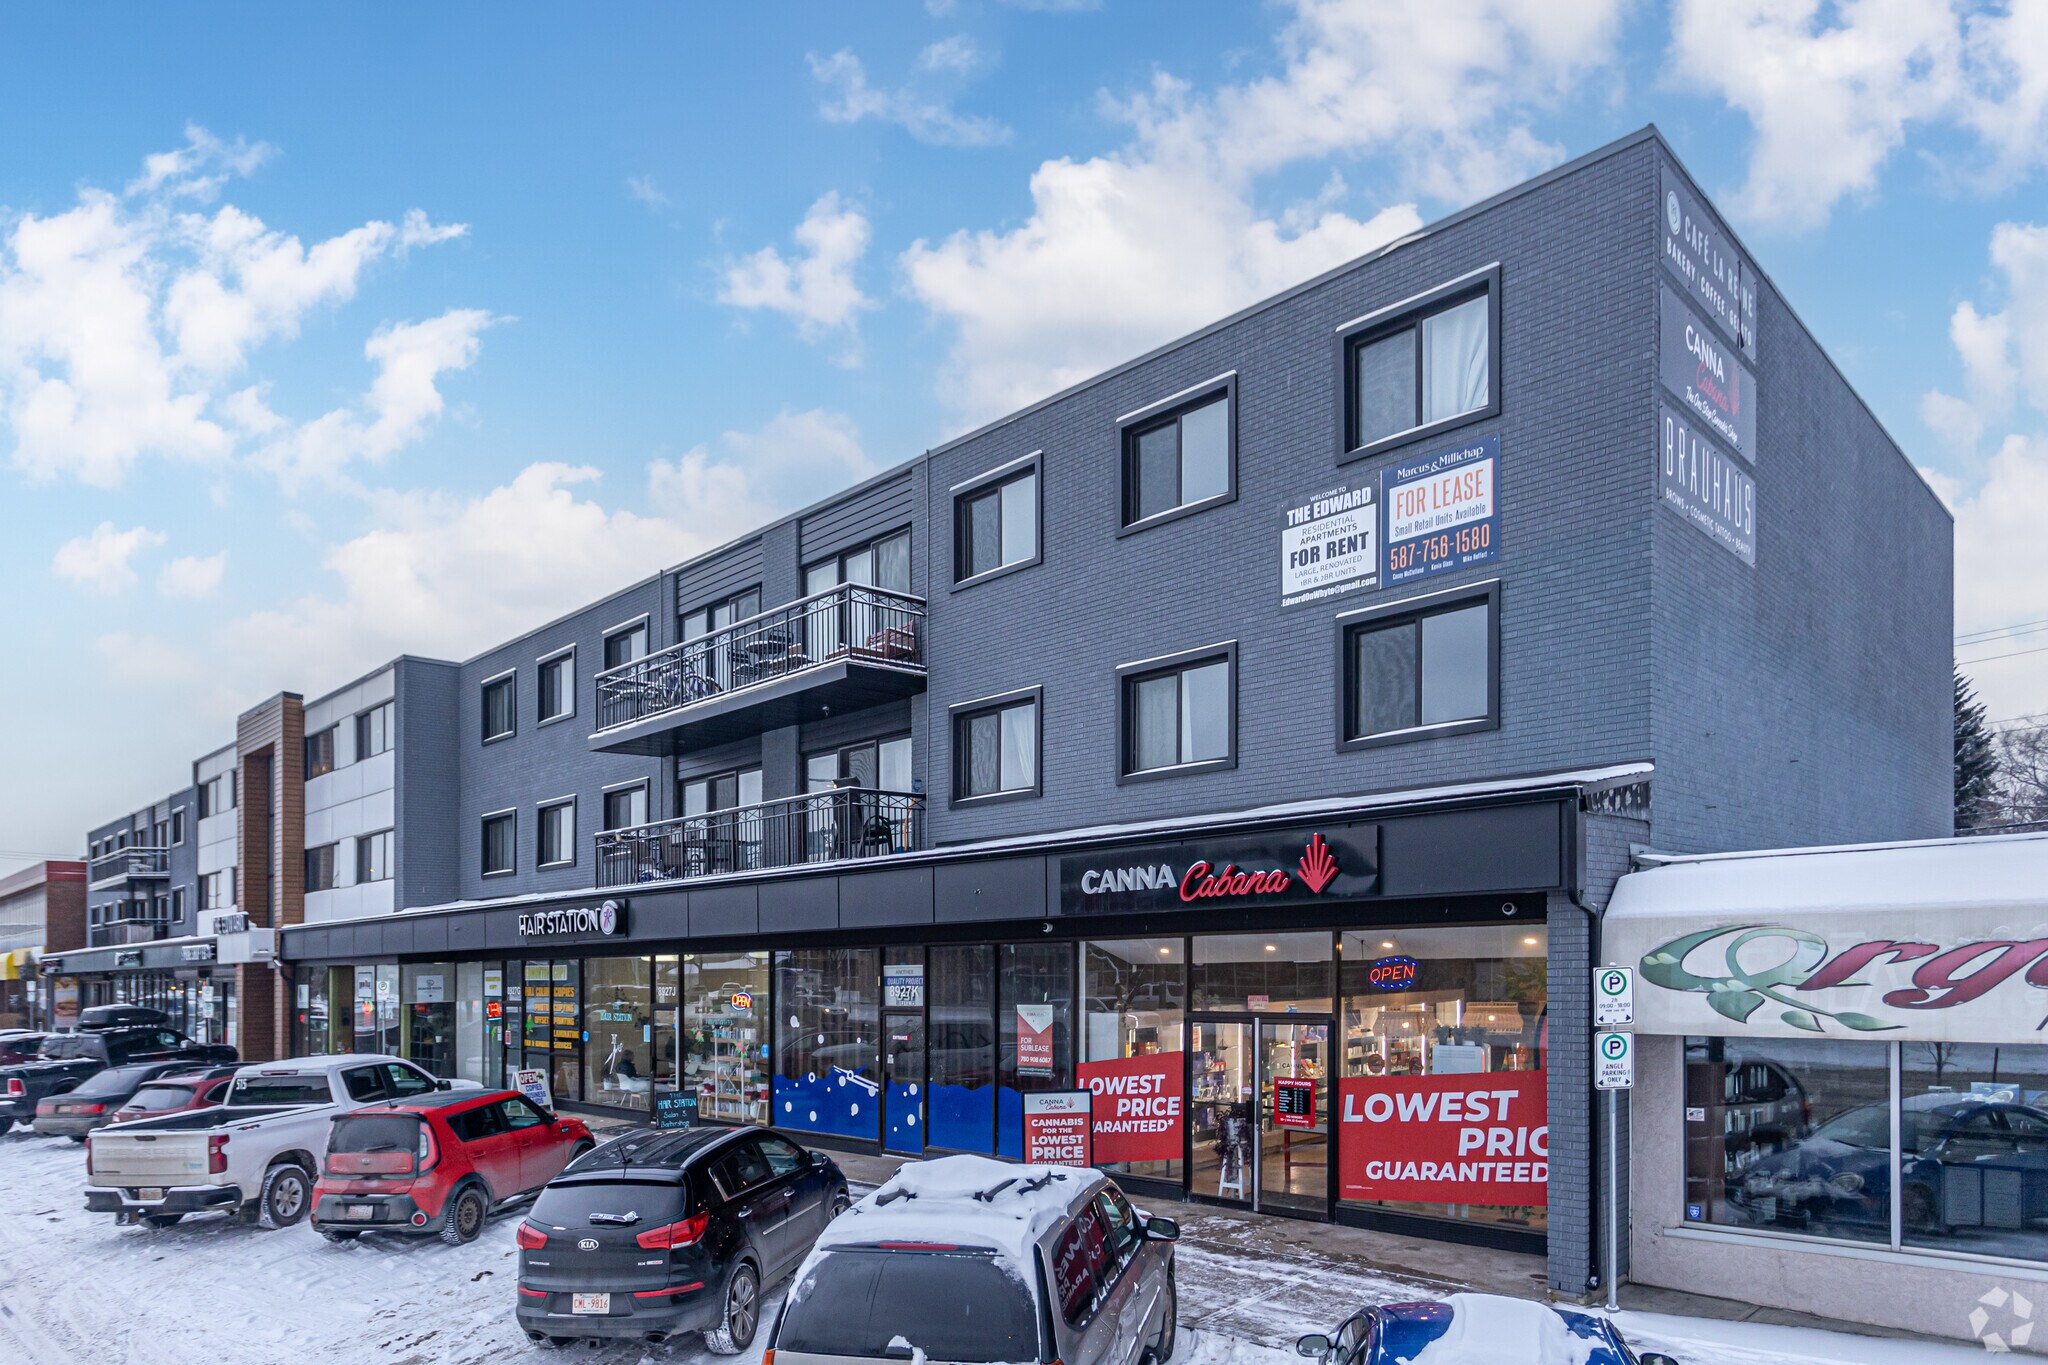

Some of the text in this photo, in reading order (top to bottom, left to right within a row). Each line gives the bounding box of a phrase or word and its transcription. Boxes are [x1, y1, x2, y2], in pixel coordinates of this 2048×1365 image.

[1667, 236, 1695, 281] BAKERY
[1701, 276, 1725, 316] COFFEE
[1685, 216, 1752, 318] CAFÉ LA RENE
[1686, 324, 1724, 383] CANNA
[1686, 386, 1694, 403] The
[1398, 447, 1484, 479] Marcus & Millichap
[1666, 417, 1751, 535] BRAUHAUS
[1310, 488, 1338, 502] WELCOME
[1397, 469, 1484, 520] FOR LEASE
[1666, 487, 1684, 509] BROWS
[1287, 486, 1371, 526] THE EDWARD
[1302, 514, 1355, 536] RESIDENTIAL
[1395, 503, 1486, 537] Small Retail Units Available
[1300, 522, 1357, 546] APARTMENTS
[1290, 531, 1369, 569] FOR RENT
[1294, 554, 1363, 579] LARGE, RENOVATED
[1321, 572, 1334, 582] 2BR
[1335, 566, 1356, 577] UNITS
[1081, 860, 1291, 902] CANNA Cabana
[518, 909, 601, 936] HAIR STATION
[887, 977, 905, 985] QUALITY
[1369, 965, 1415, 982] OPEN
[1609, 976, 1621, 990] P
[1639, 922, 2048, 1026] Org
[731, 993, 752, 1008] OPEN
[889, 985, 919, 998] 8927K
[1609, 1040, 1621, 1054] P
[658, 1098, 697, 1109] HAIR STATION
[1116, 1096, 1181, 1117] PRICE
[1343, 1089, 1519, 1122] LOWEST
[1031, 1118, 1084, 1127] CANNABIS
[1093, 1118, 1174, 1133] ARANTEED
[1031, 1135, 1084, 1145] LOWEST
[1458, 1127, 1548, 1157] PRIC
[1031, 1146, 1084, 1159] PRICE
[580, 1240, 596, 1248] KIA
[574, 1299, 608, 1309] CML-9816
